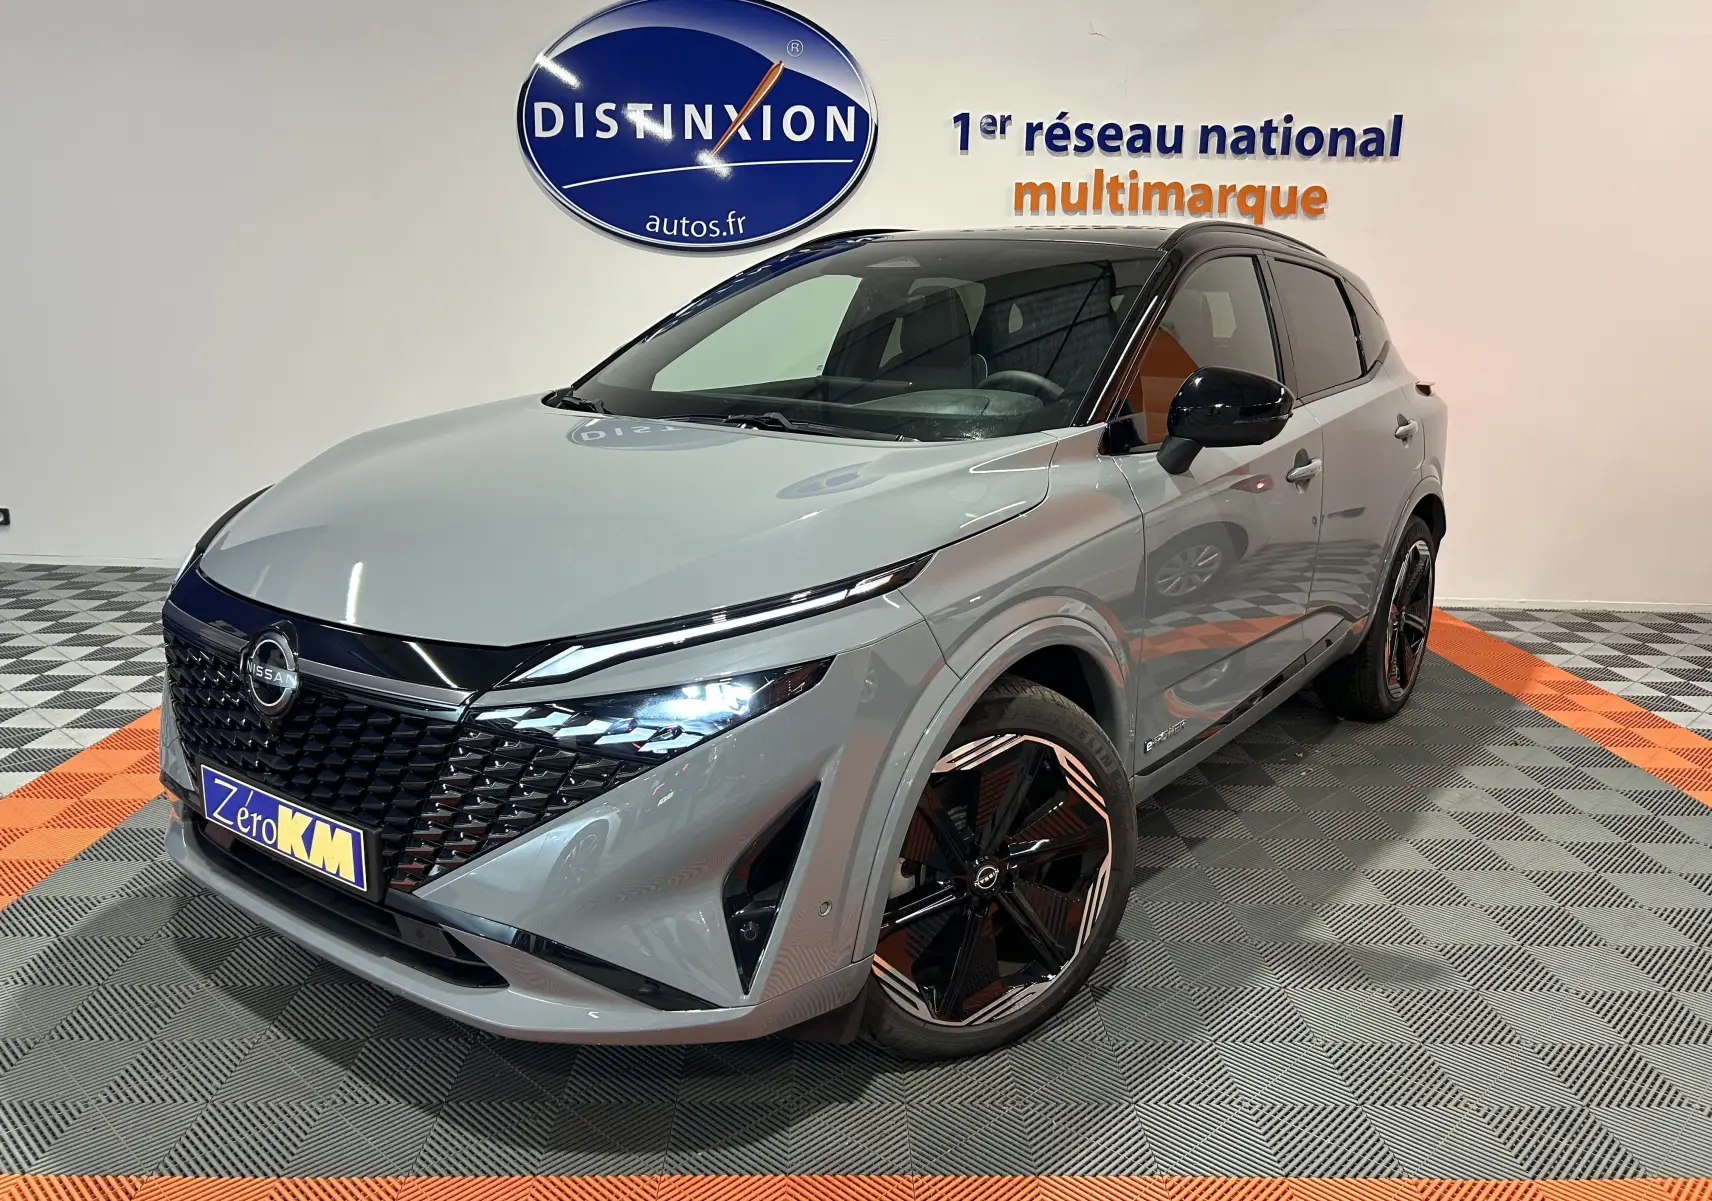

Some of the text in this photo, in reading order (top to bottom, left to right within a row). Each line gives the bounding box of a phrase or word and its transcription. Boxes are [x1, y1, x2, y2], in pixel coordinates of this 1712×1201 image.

[533, 101, 856, 142] DISTINXION
[951, 109, 1404, 157] 1er réseau national
[1013, 168, 1329, 225] multimarque
[645, 210, 747, 238] autos.fr
[247, 660, 298, 686] NISSAN
